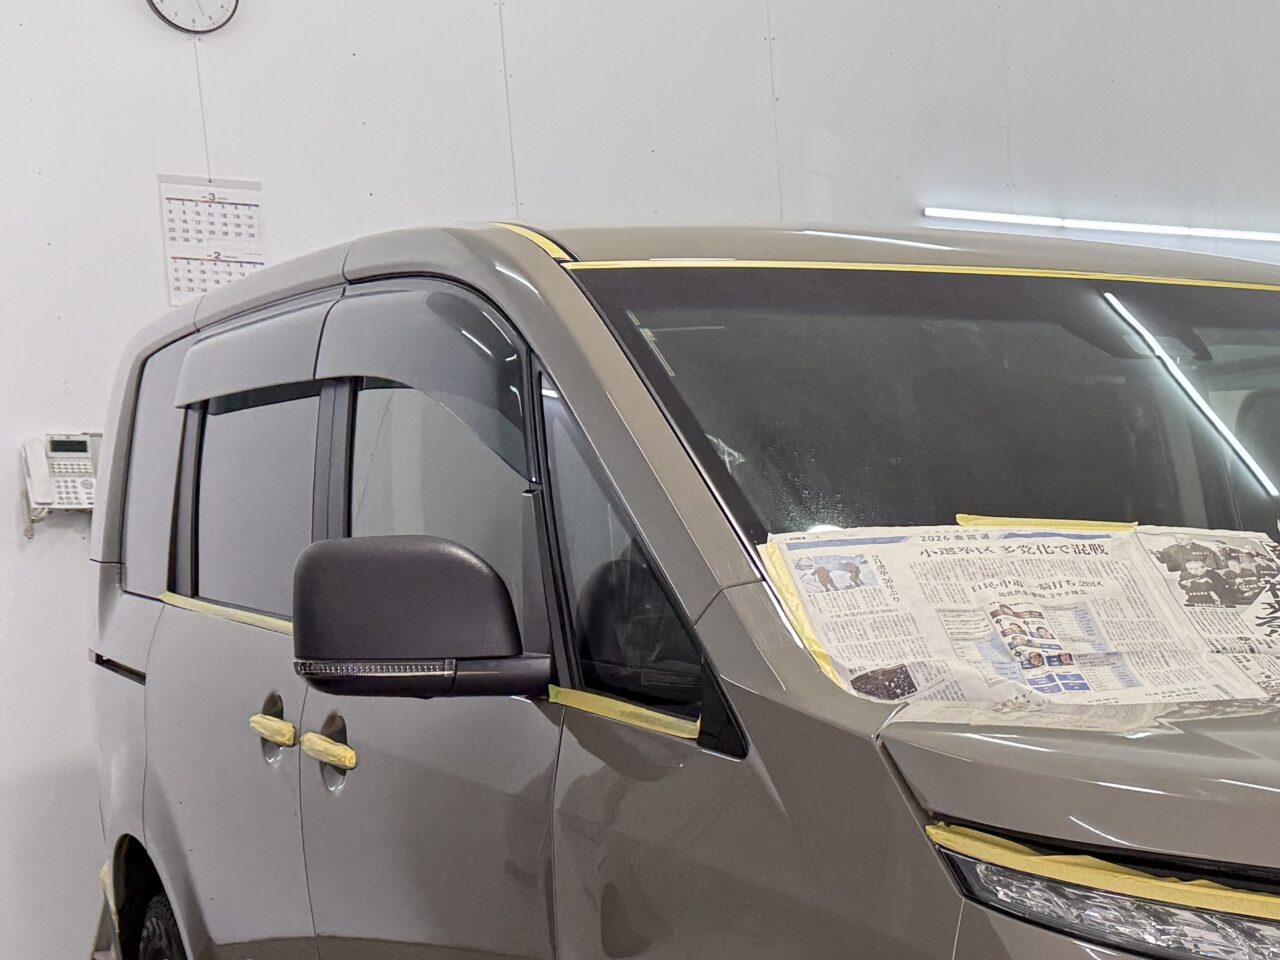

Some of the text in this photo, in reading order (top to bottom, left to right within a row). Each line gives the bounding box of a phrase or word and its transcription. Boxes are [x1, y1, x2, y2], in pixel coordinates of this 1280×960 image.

[209, 193, 215, 201] 3
[213, 251, 221, 259] 2
[919, 534, 950, 542] 2026
